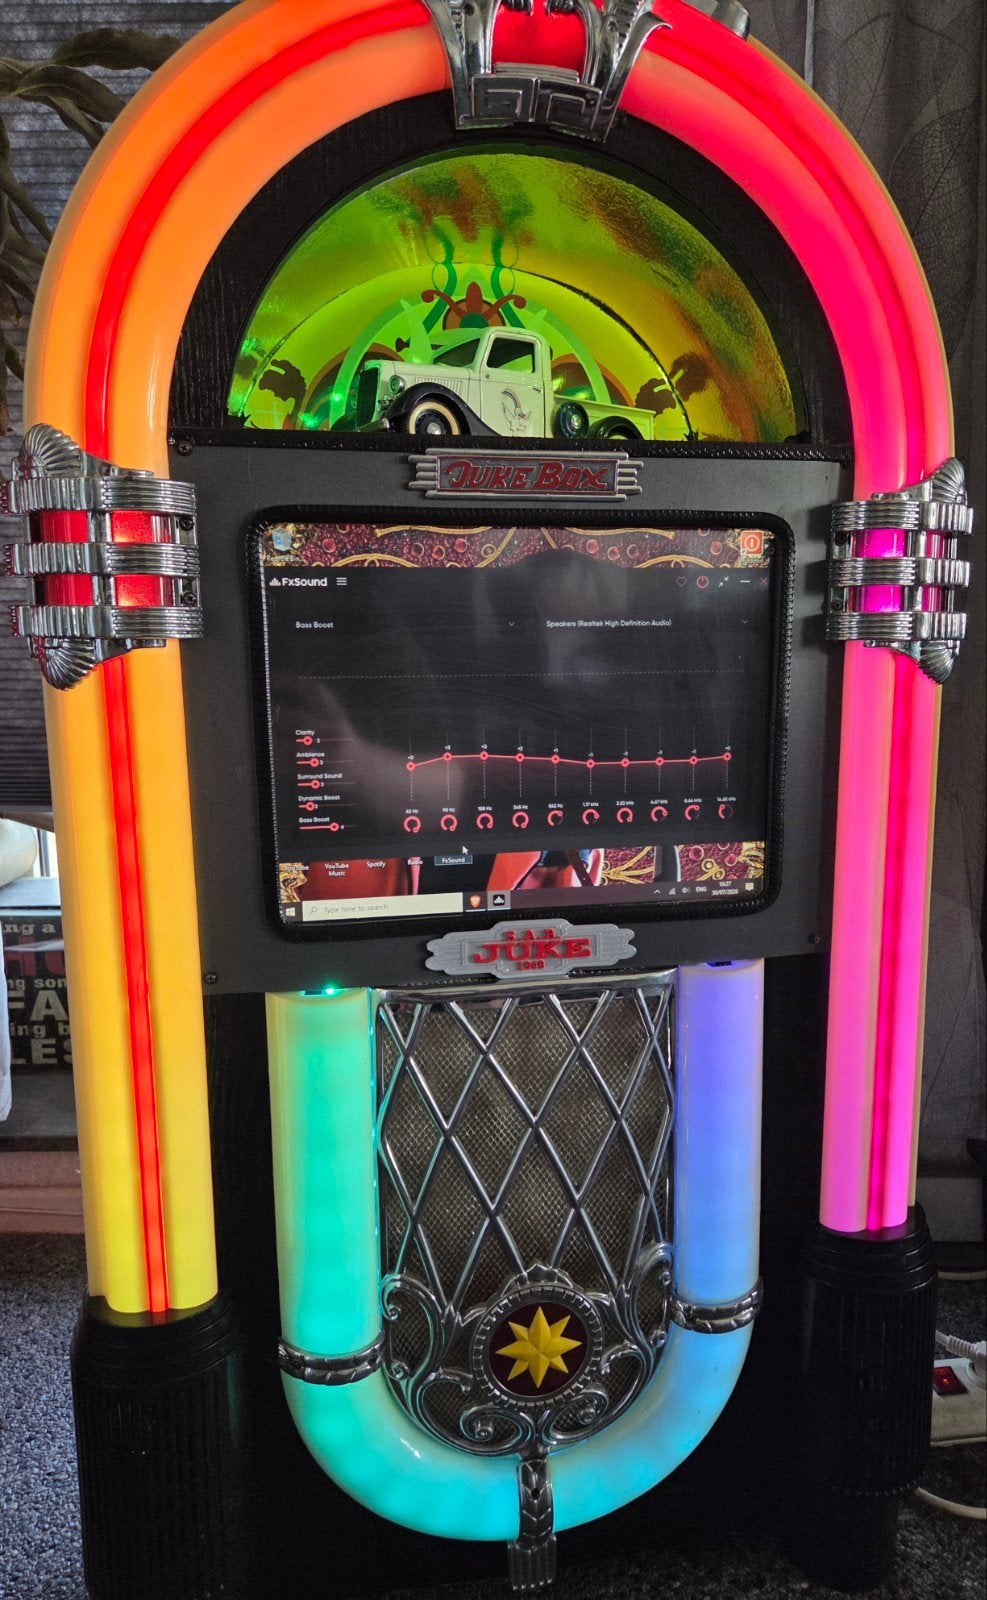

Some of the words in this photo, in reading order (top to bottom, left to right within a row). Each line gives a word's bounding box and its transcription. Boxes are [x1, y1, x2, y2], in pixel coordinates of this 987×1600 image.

[444, 460, 535, 489] JUKE
[534, 461, 609, 489] BOX
[282, 577, 328, 586] FxSound
[546, 620, 576, 628] Speakers
[577, 619, 603, 628] (Realtek
[604, 619, 620, 628] High
[620, 619, 651, 627] Definition
[651, 619, 672, 627] Audio)
[366, 860, 387, 869] Spotify
[473, 938, 591, 963] JUKE
